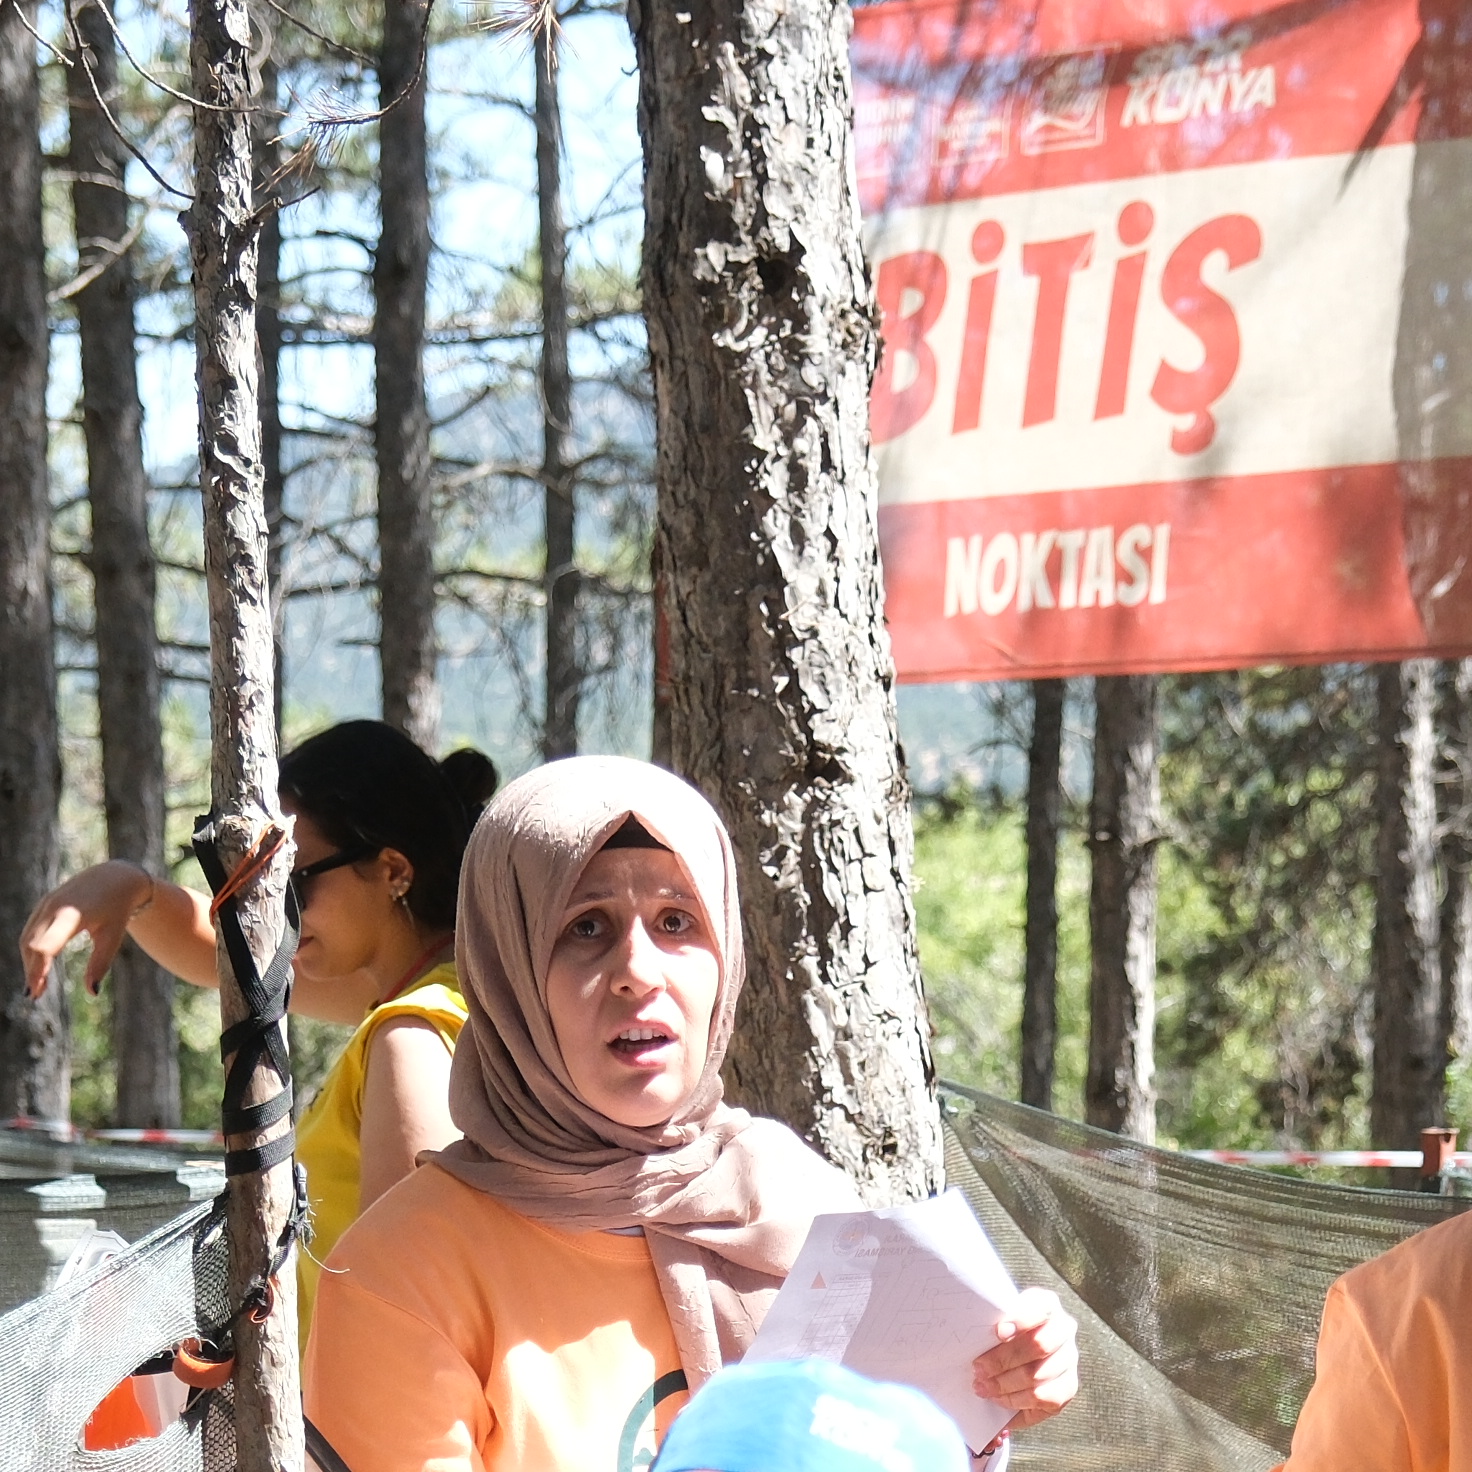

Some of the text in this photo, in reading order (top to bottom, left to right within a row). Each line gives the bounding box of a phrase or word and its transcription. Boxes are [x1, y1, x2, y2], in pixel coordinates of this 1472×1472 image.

[1119, 64, 1276, 128] KONYA
[870, 200, 1263, 457] BİTİŞ
[944, 521, 1172, 619] NOKTASI
